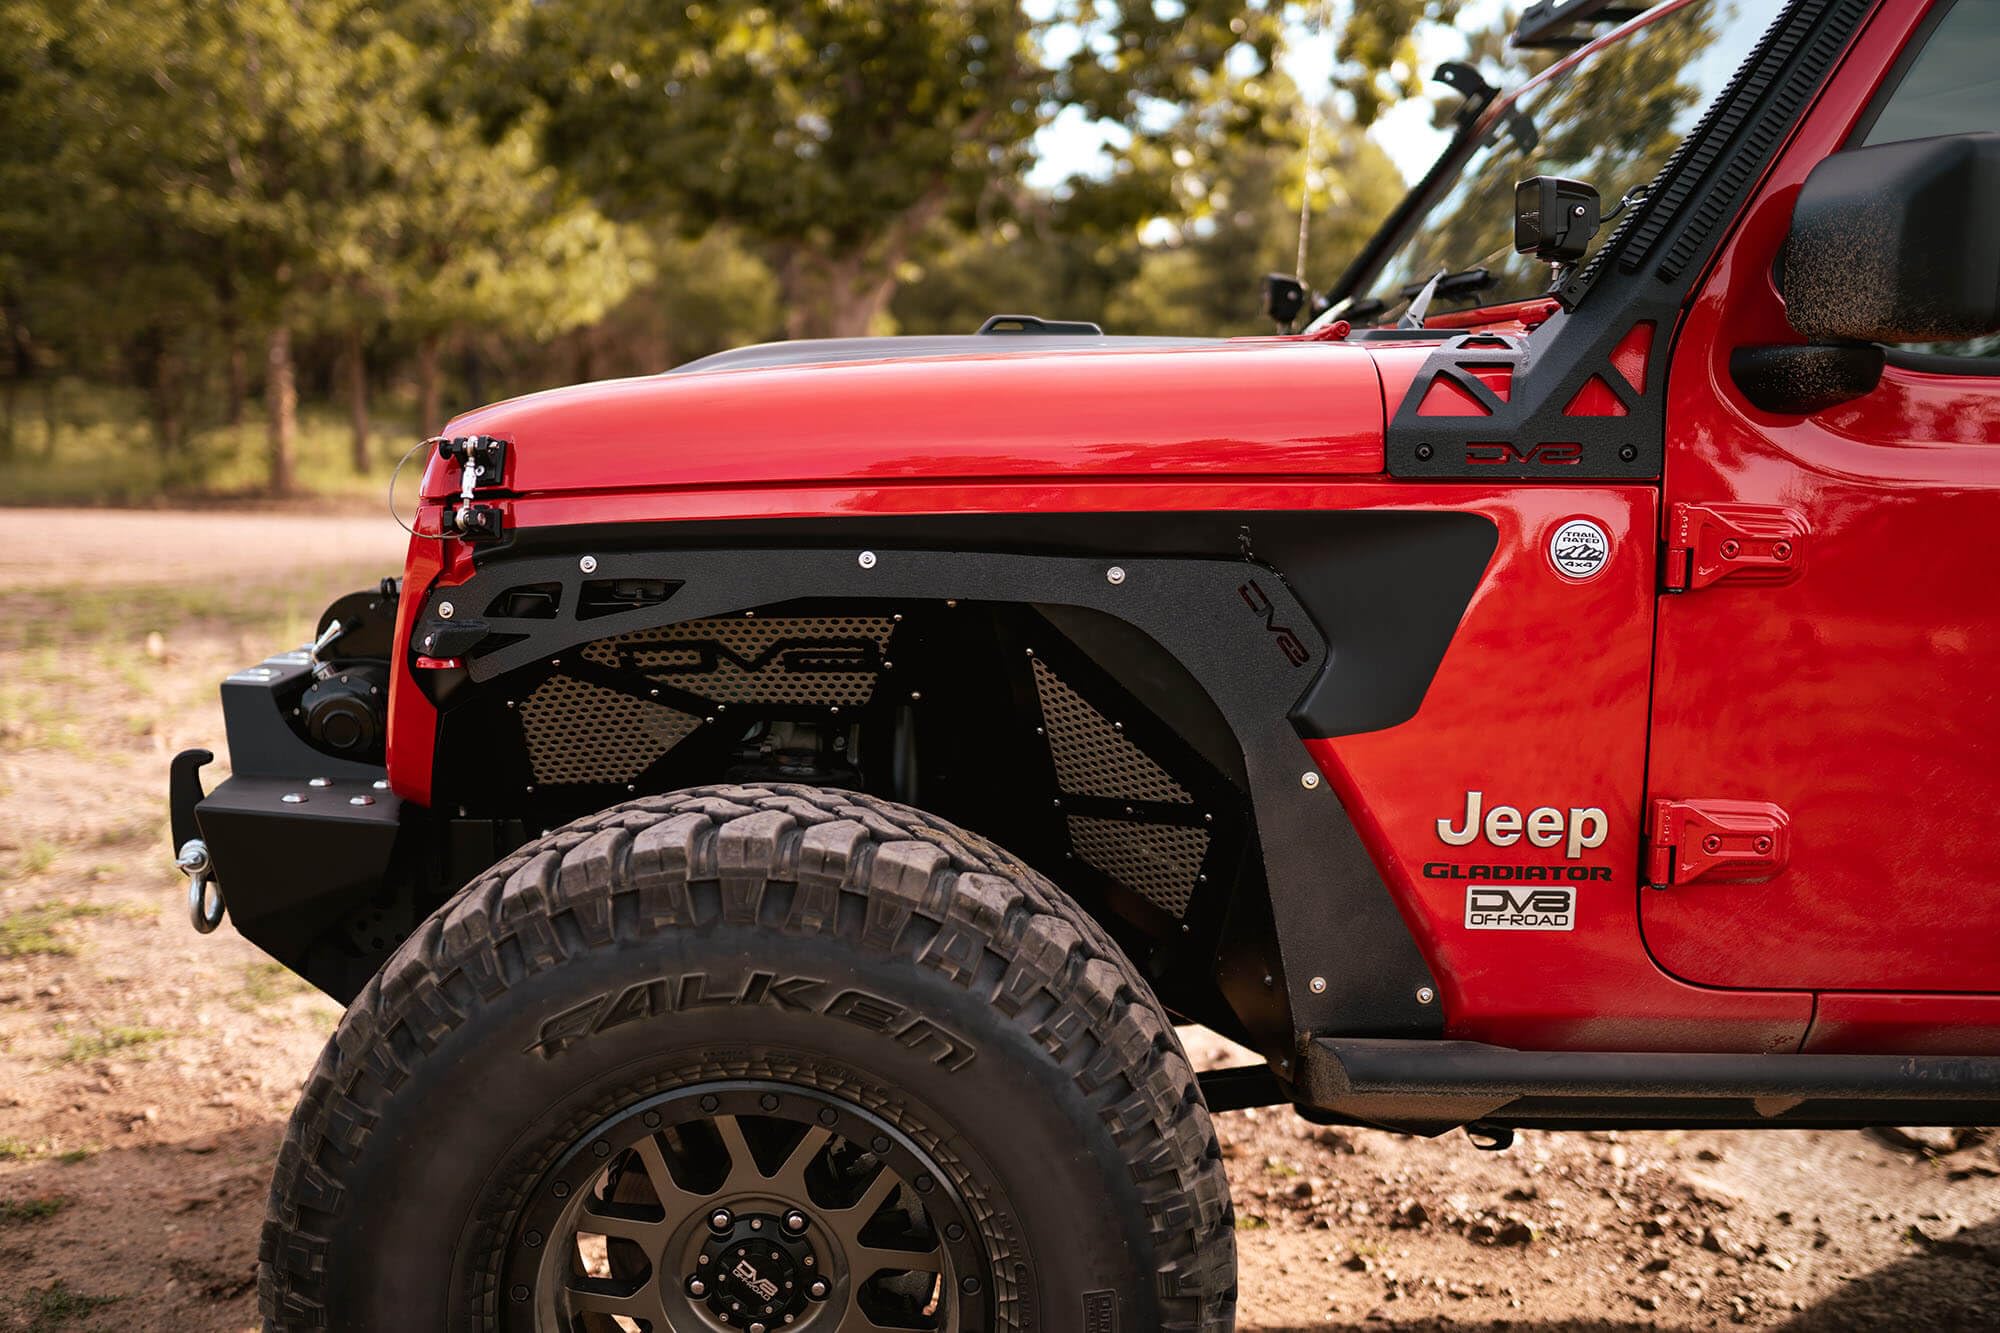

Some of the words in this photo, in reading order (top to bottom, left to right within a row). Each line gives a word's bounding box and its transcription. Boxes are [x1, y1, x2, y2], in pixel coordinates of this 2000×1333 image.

[1437, 791, 1608, 858] Jeep
[1422, 862, 1613, 881] GLADIATOR
[1471, 890, 1570, 913] DV8
[522, 969, 977, 1074] FALKEN
